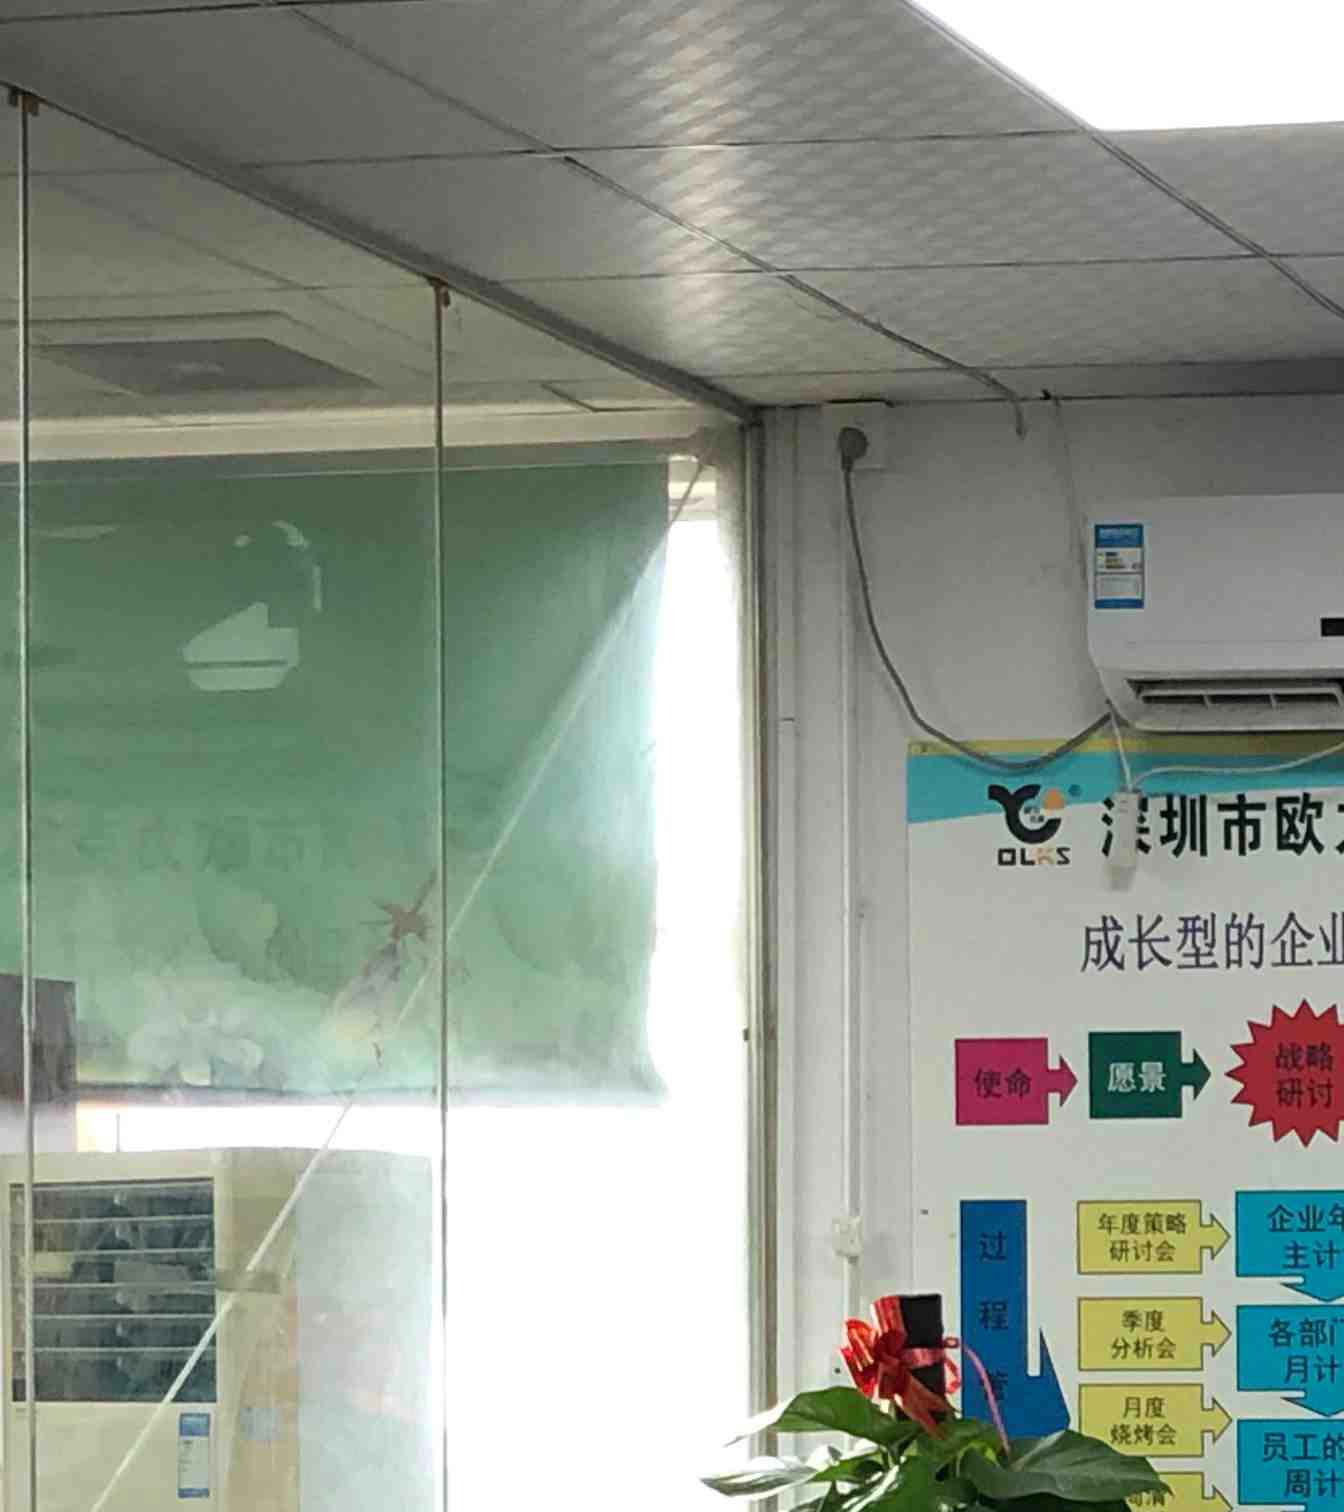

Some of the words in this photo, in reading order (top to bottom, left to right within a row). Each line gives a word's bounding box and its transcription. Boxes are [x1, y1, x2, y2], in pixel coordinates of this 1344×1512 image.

[1276, 1042, 1334, 1073] 战略
[974, 1067, 1032, 1100] 使命
[1107, 1061, 1166, 1093] 愿景
[1276, 1077, 1334, 1109] 研讨
[1098, 1212, 1187, 1236] 年度策略
[1109, 1240, 1177, 1264] 研讨会
[1121, 1309, 1164, 1333] 季度
[1111, 1337, 1177, 1361] 分析会
[1122, 1396, 1166, 1420] 月度
